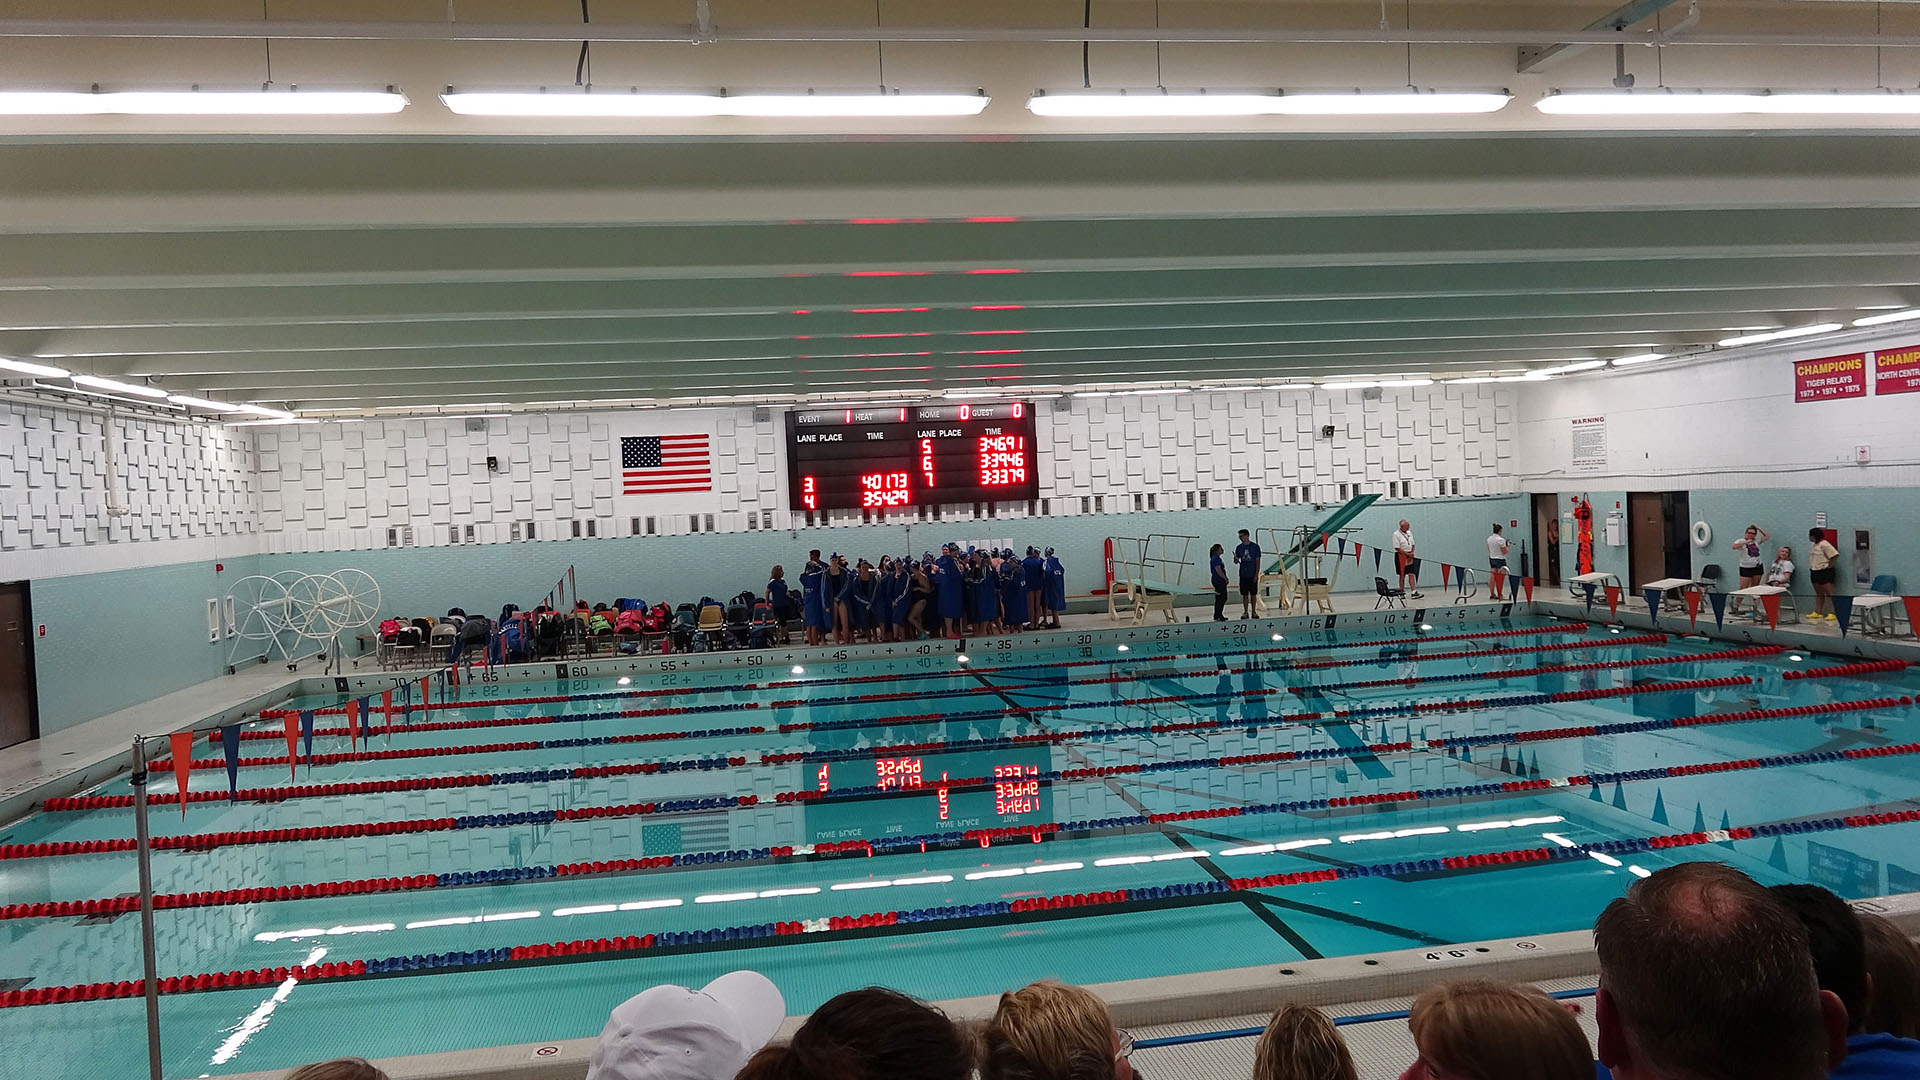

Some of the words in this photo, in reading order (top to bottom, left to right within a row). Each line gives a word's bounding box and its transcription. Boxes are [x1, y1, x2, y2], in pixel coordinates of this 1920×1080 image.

[1797, 359, 1862, 376] CHAMPIONS
[1877, 371, 1898, 380] NORTH
[1899, 368, 1920, 378] CENTR
[1806, 379, 1825, 387] TIGER
[1827, 376, 1852, 385] RELAYS
[1906, 379, 1920, 387] 197
[1800, 389, 1815, 398] 1973
[1822, 387, 1837, 395] 1974
[1845, 385, 1860, 393] 1975
[799, 415, 821, 423] EVENT
[855, 413, 873, 421] HEAT
[920, 411, 940, 419] HOME
[972, 409, 994, 417] GUEST
[1572, 416, 1605, 424] WARNING
[797, 434, 817, 443] LANE
[819, 433, 843, 442] PLACE
[866, 432, 884, 440] TIME
[917, 430, 936, 438] LANE
[939, 429, 962, 437] PLACE
[984, 427, 1002, 435] TIME
[1309, 619, 1321, 629] 15
[1384, 614, 1396, 624] 10
[1155, 629, 1170, 639] 25
[1233, 624, 1247, 634] 20
[997, 639, 1012, 649] 35
[1077, 634, 1092, 645] 30
[832, 650, 848, 660] 45
[916, 645, 930, 655] 40
[747, 655, 763, 666] 50
[661, 661, 677, 671] 55
[572, 666, 588, 677] 60
